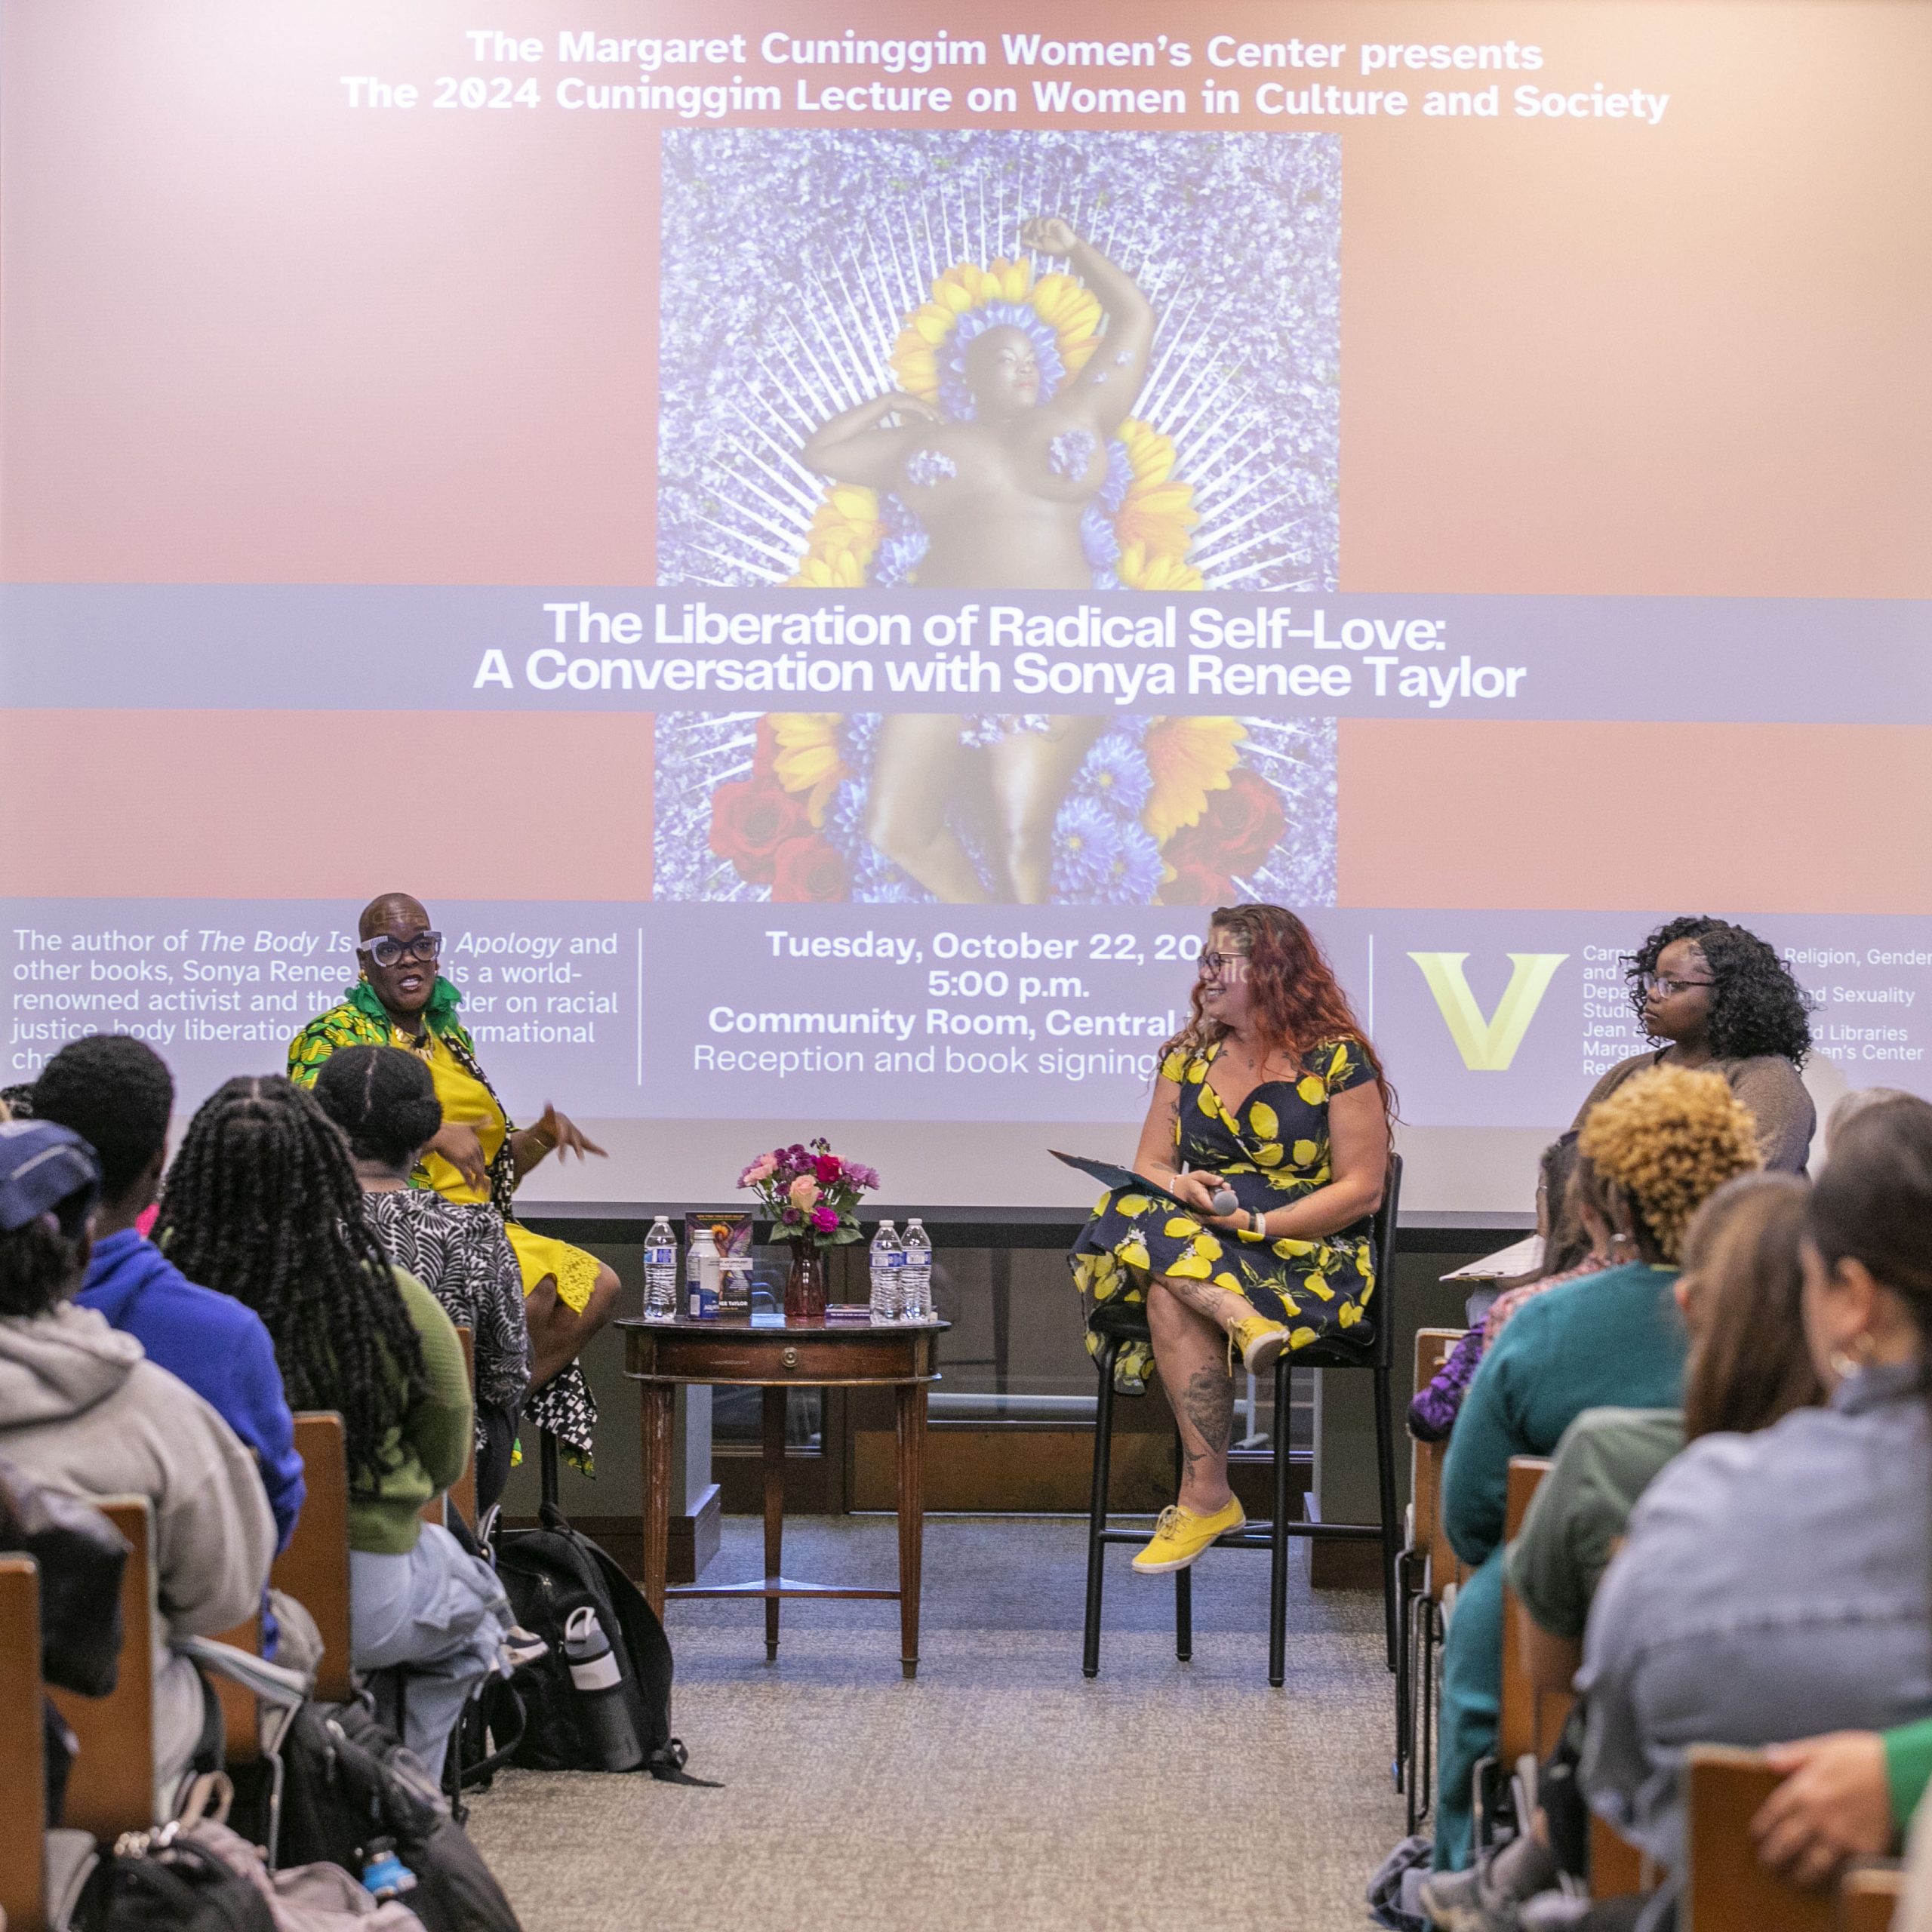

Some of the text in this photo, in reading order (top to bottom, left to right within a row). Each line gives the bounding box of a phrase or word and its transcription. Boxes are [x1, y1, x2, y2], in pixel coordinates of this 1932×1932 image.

[465, 29, 1545, 75] The Margaret Cuninggim Women's Center presents
[339, 74, 1671, 125] The 2024 Cuninggim Lecture on Women in Culture and Society
[543, 601, 1446, 651] The Liberation of Radical Self-Love:
[472, 648, 1527, 709] A Conversation with Sonya Renee Taylor
[13, 929, 63, 951] The
[71, 929, 155, 952] author
[163, 929, 189, 952] of
[198, 930, 246, 952] The
[253, 930, 320, 957] Body
[325, 931, 352, 952] Is
[454, 931, 562, 959] Apology
[569, 932, 617, 955] and
[764, 930, 923, 965] Tuesday,
[932, 931, 1079, 959] October
[1089, 933, 1145, 966] 22,
[1154, 934, 1202, 961] 20
[1784, 947, 1861, 968] Religion,
[13, 958, 583, 986] other books, Sonya Renee is a world-
[928, 970, 1090, 1004] 5:00 p.m.
[1583, 964, 1617, 980] and
[13, 989, 139, 1011] renowned
[148, 988, 242, 1011] activist
[250, 989, 297, 1012] and
[506, 995, 537, 1013] on
[547, 990, 618, 1014] racial
[1832, 986, 1915, 1008] Sexuality
[113, 1018, 177, 1045] body
[462, 1020, 595, 1043] rmational
[709, 1006, 1175, 1041] Community Room, Central
[1583, 1021, 1626, 1038] Jean
[1829, 1024, 1909, 1041] Libraries
[694, 1044, 1158, 1082] Reception and book signing
[1862, 1044, 1924, 1060] Center
